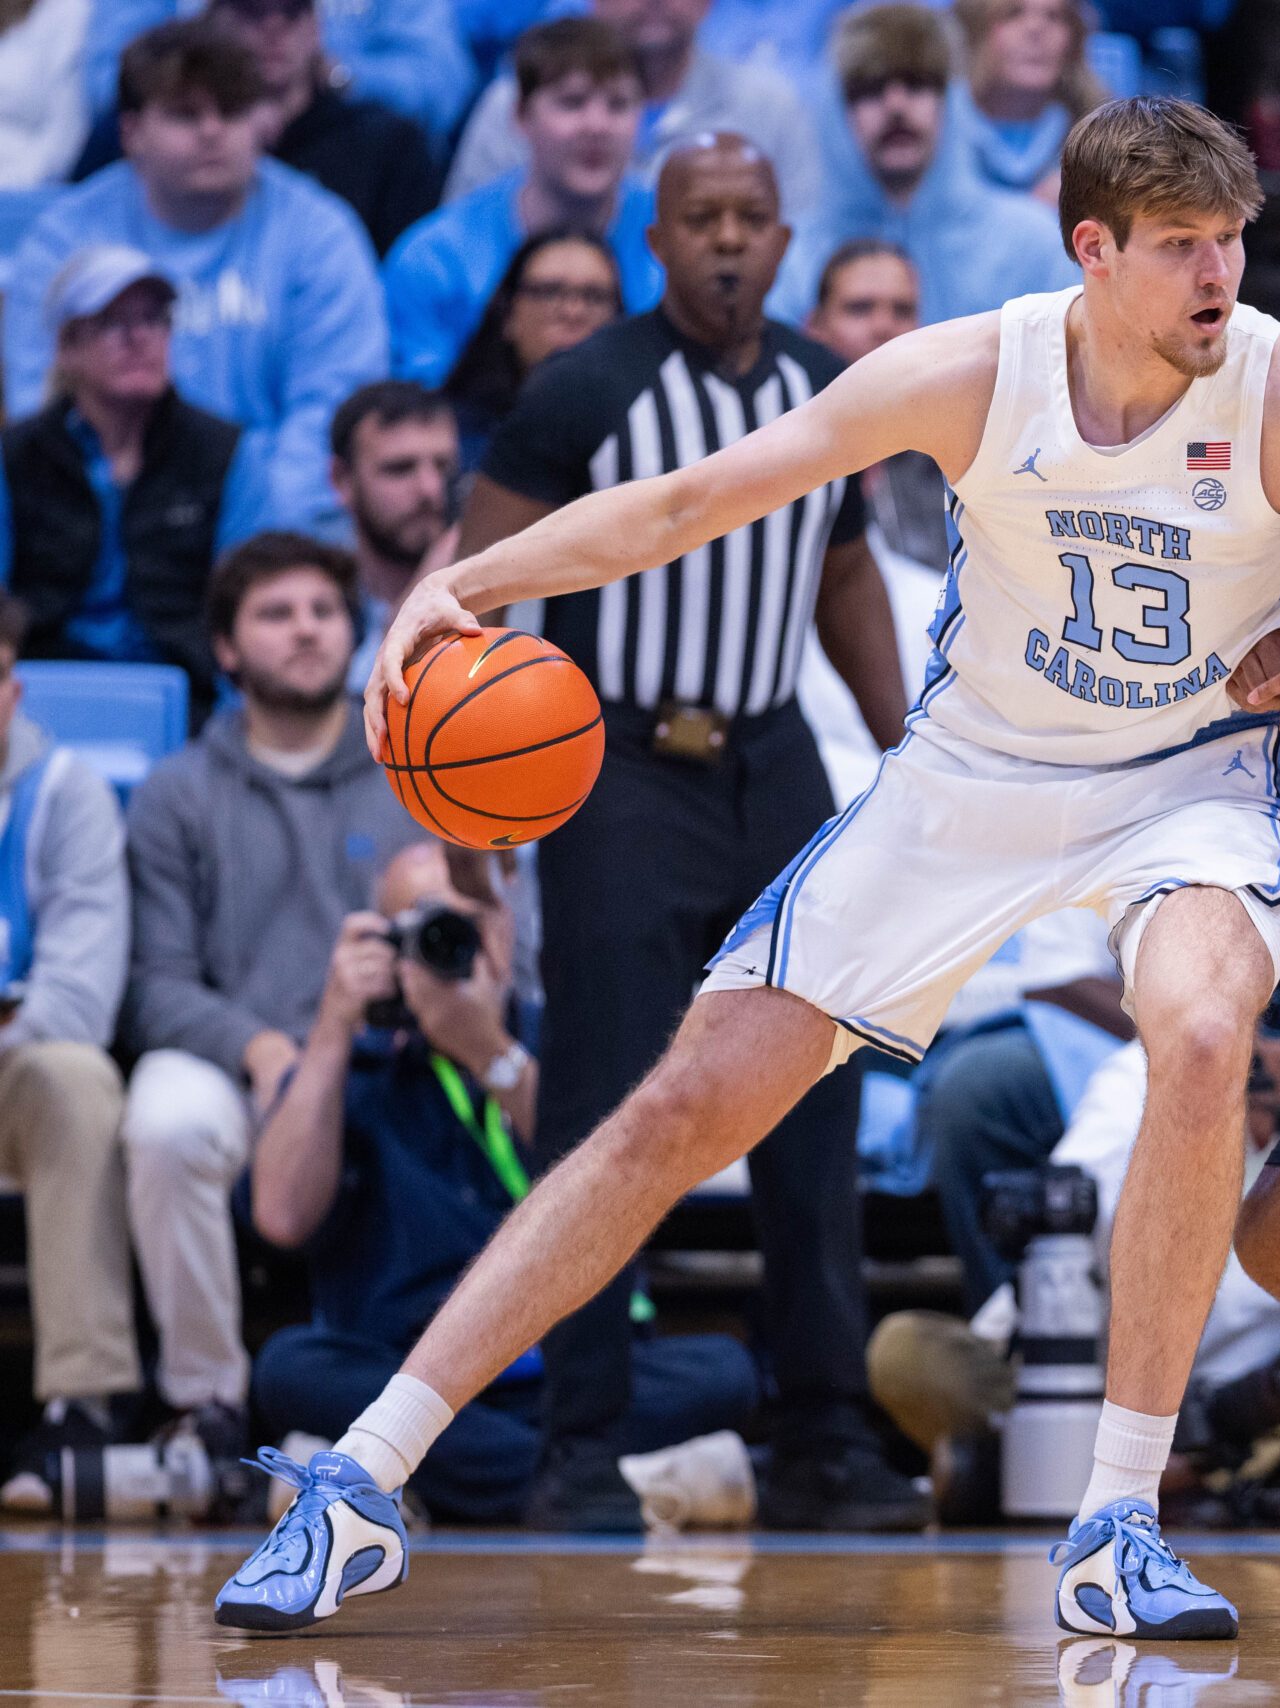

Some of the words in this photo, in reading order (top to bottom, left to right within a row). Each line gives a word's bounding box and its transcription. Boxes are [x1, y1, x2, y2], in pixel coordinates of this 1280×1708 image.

[1197, 489, 1224, 497] ACC
[1045, 510, 1191, 561] NORTH
[1058, 552, 1191, 666] 13
[1024, 627, 1231, 709] CAROLINA
